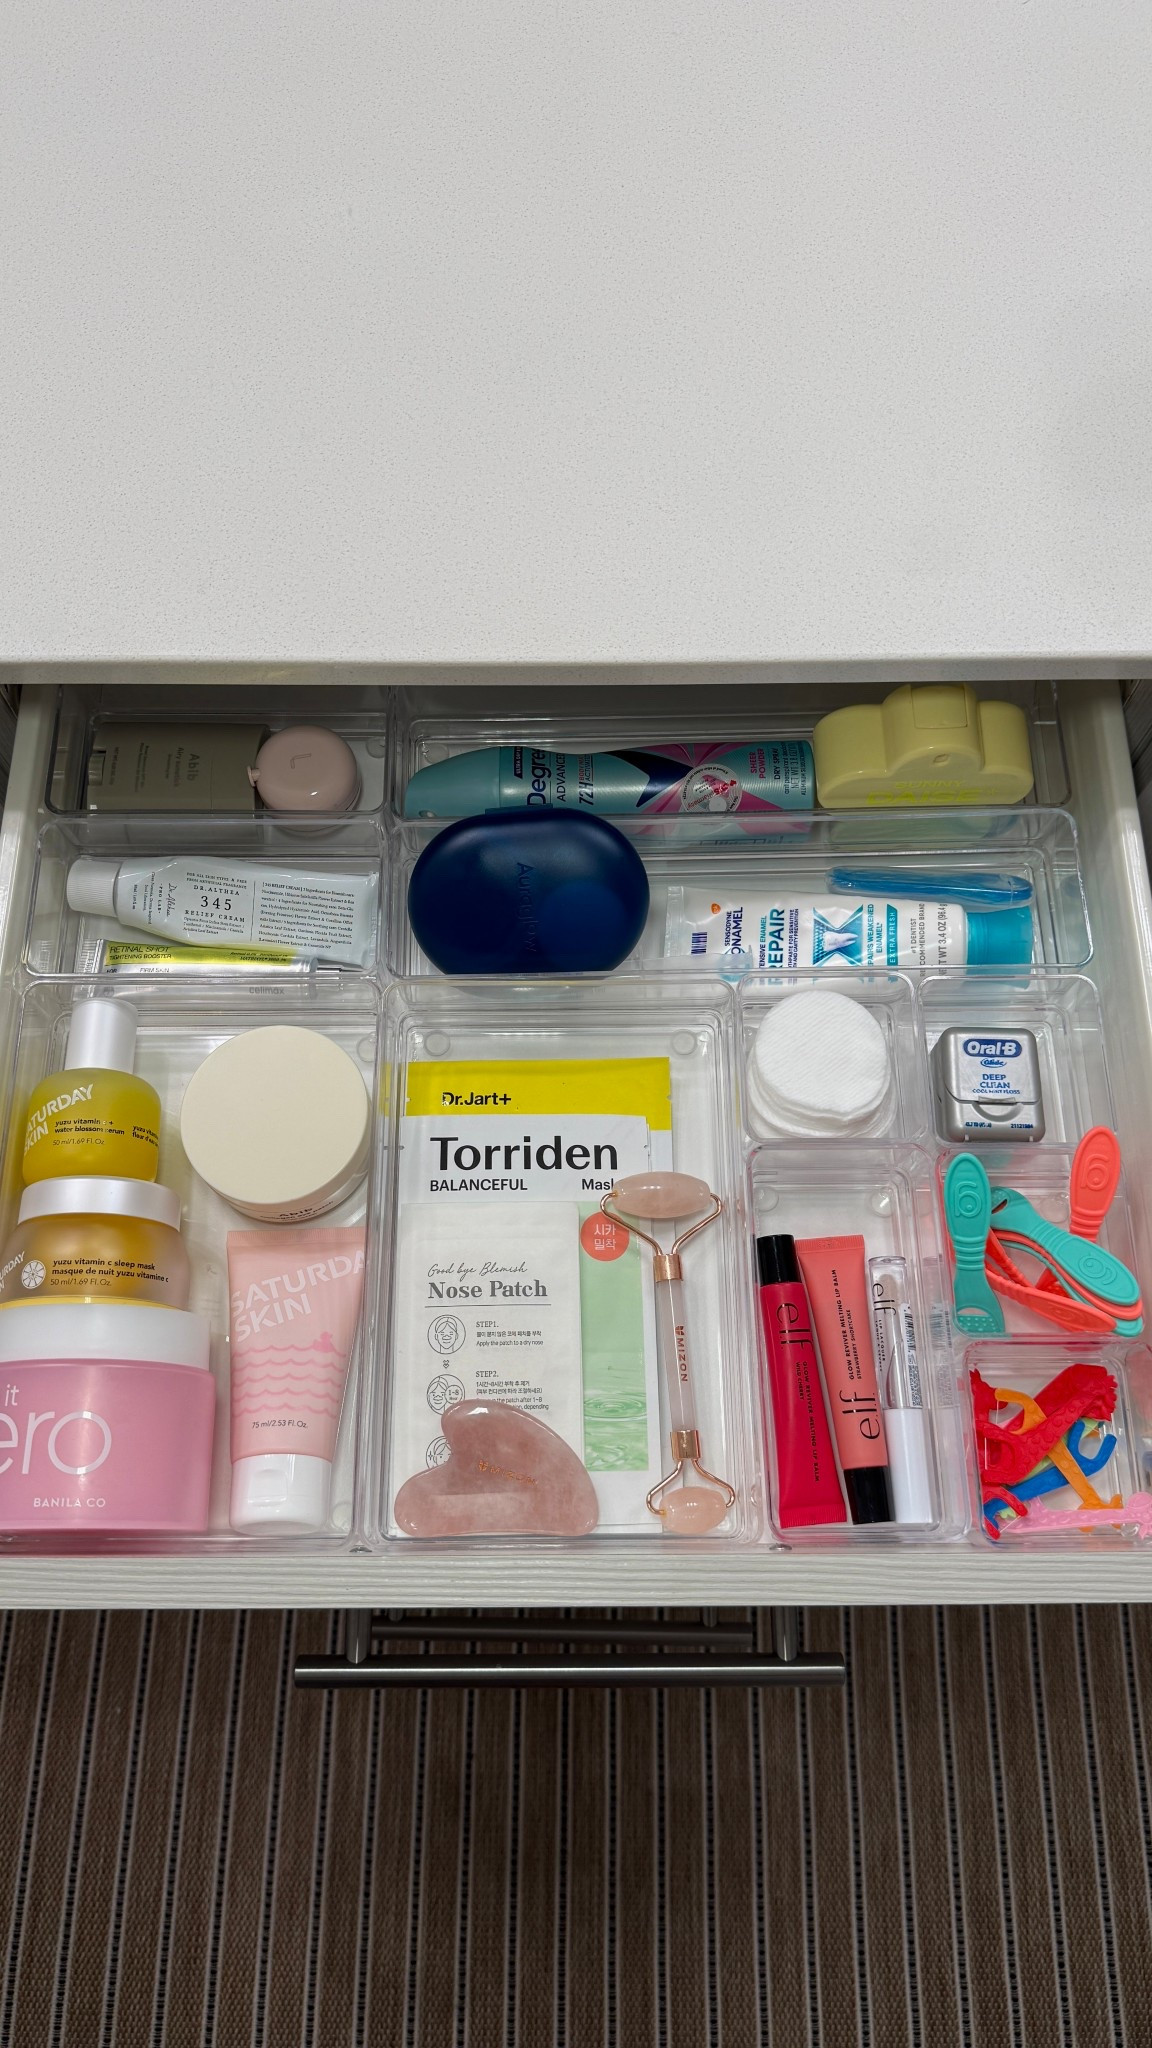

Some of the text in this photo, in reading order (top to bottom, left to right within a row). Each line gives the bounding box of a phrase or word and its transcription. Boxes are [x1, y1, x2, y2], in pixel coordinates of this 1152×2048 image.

[187, 753, 200, 781] Abib
[749, 751, 758, 773] SHEER
[758, 748, 766, 779] POWDER
[773, 767, 781, 780] DRY
[896, 780, 964, 789] SUNNY
[578, 781, 594, 806] 72H
[867, 789, 981, 805] DAISE
[200, 895, 232, 911] 345
[185, 910, 245, 922] RELIEF CREAM
[724, 910, 732, 946] SENSODYNE
[731, 907, 743, 955] ONAMEL
[759, 915, 767, 943] ENAMEL
[937, 921, 947, 931] OZ
[938, 932, 947, 944] 3.4
[110, 945, 143, 953] RETINAL
[938, 946, 947, 958] WT
[249, 986, 285, 995] celimax
[967, 1041, 1017, 1055] Oral-B
[980, 1081, 1010, 1089] CLEAN
[442, 1092, 512, 1107] Dr.Jart+
[26, 1083, 94, 1132] ATURDAY
[54, 1126, 73, 1134] water
[55, 1119, 72, 1127] yuzu
[132, 1125, 145, 1133] yuzu
[429, 1135, 618, 1171] Torriden
[430, 1179, 528, 1192] BALANCEFUL
[594, 1224, 616, 1236] 시카
[594, 1238, 616, 1251] 밀착
[0, 1250, 25, 1281] URDAY
[53, 1259, 72, 1267] yuzu
[74, 1258, 105, 1266] vitamin
[114, 1260, 135, 1269] sleep
[137, 1262, 156, 1270] mask
[427, 1261, 528, 1282] Good bye Blemish
[50, 1278, 60, 1286] 50
[60, 1278, 88, 1286] ml/1.69
[52, 1268, 84, 1276] masque
[116, 1270, 135, 1278] yuzu
[136, 1270, 164, 1281] vitamine
[831, 1269, 839, 1287] BALM
[231, 1250, 365, 1318] SATURDA
[428, 1279, 548, 1299] Nose Patch
[235, 1293, 311, 1343] SKIN
[836, 1300, 846, 1328] MELTING
[475, 1320, 499, 1328] STEP1.
[842, 1330, 851, 1357] REVIVER
[846, 1309, 862, 1379] STRAWBERRY SHORTCAKE
[677, 1338, 688, 1382] MIZON
[475, 1370, 499, 1378] STEP2.
[4, 1384, 20, 1407] it
[0, 1411, 112, 1475] ero
[33, 1498, 106, 1508] BANILA CO
